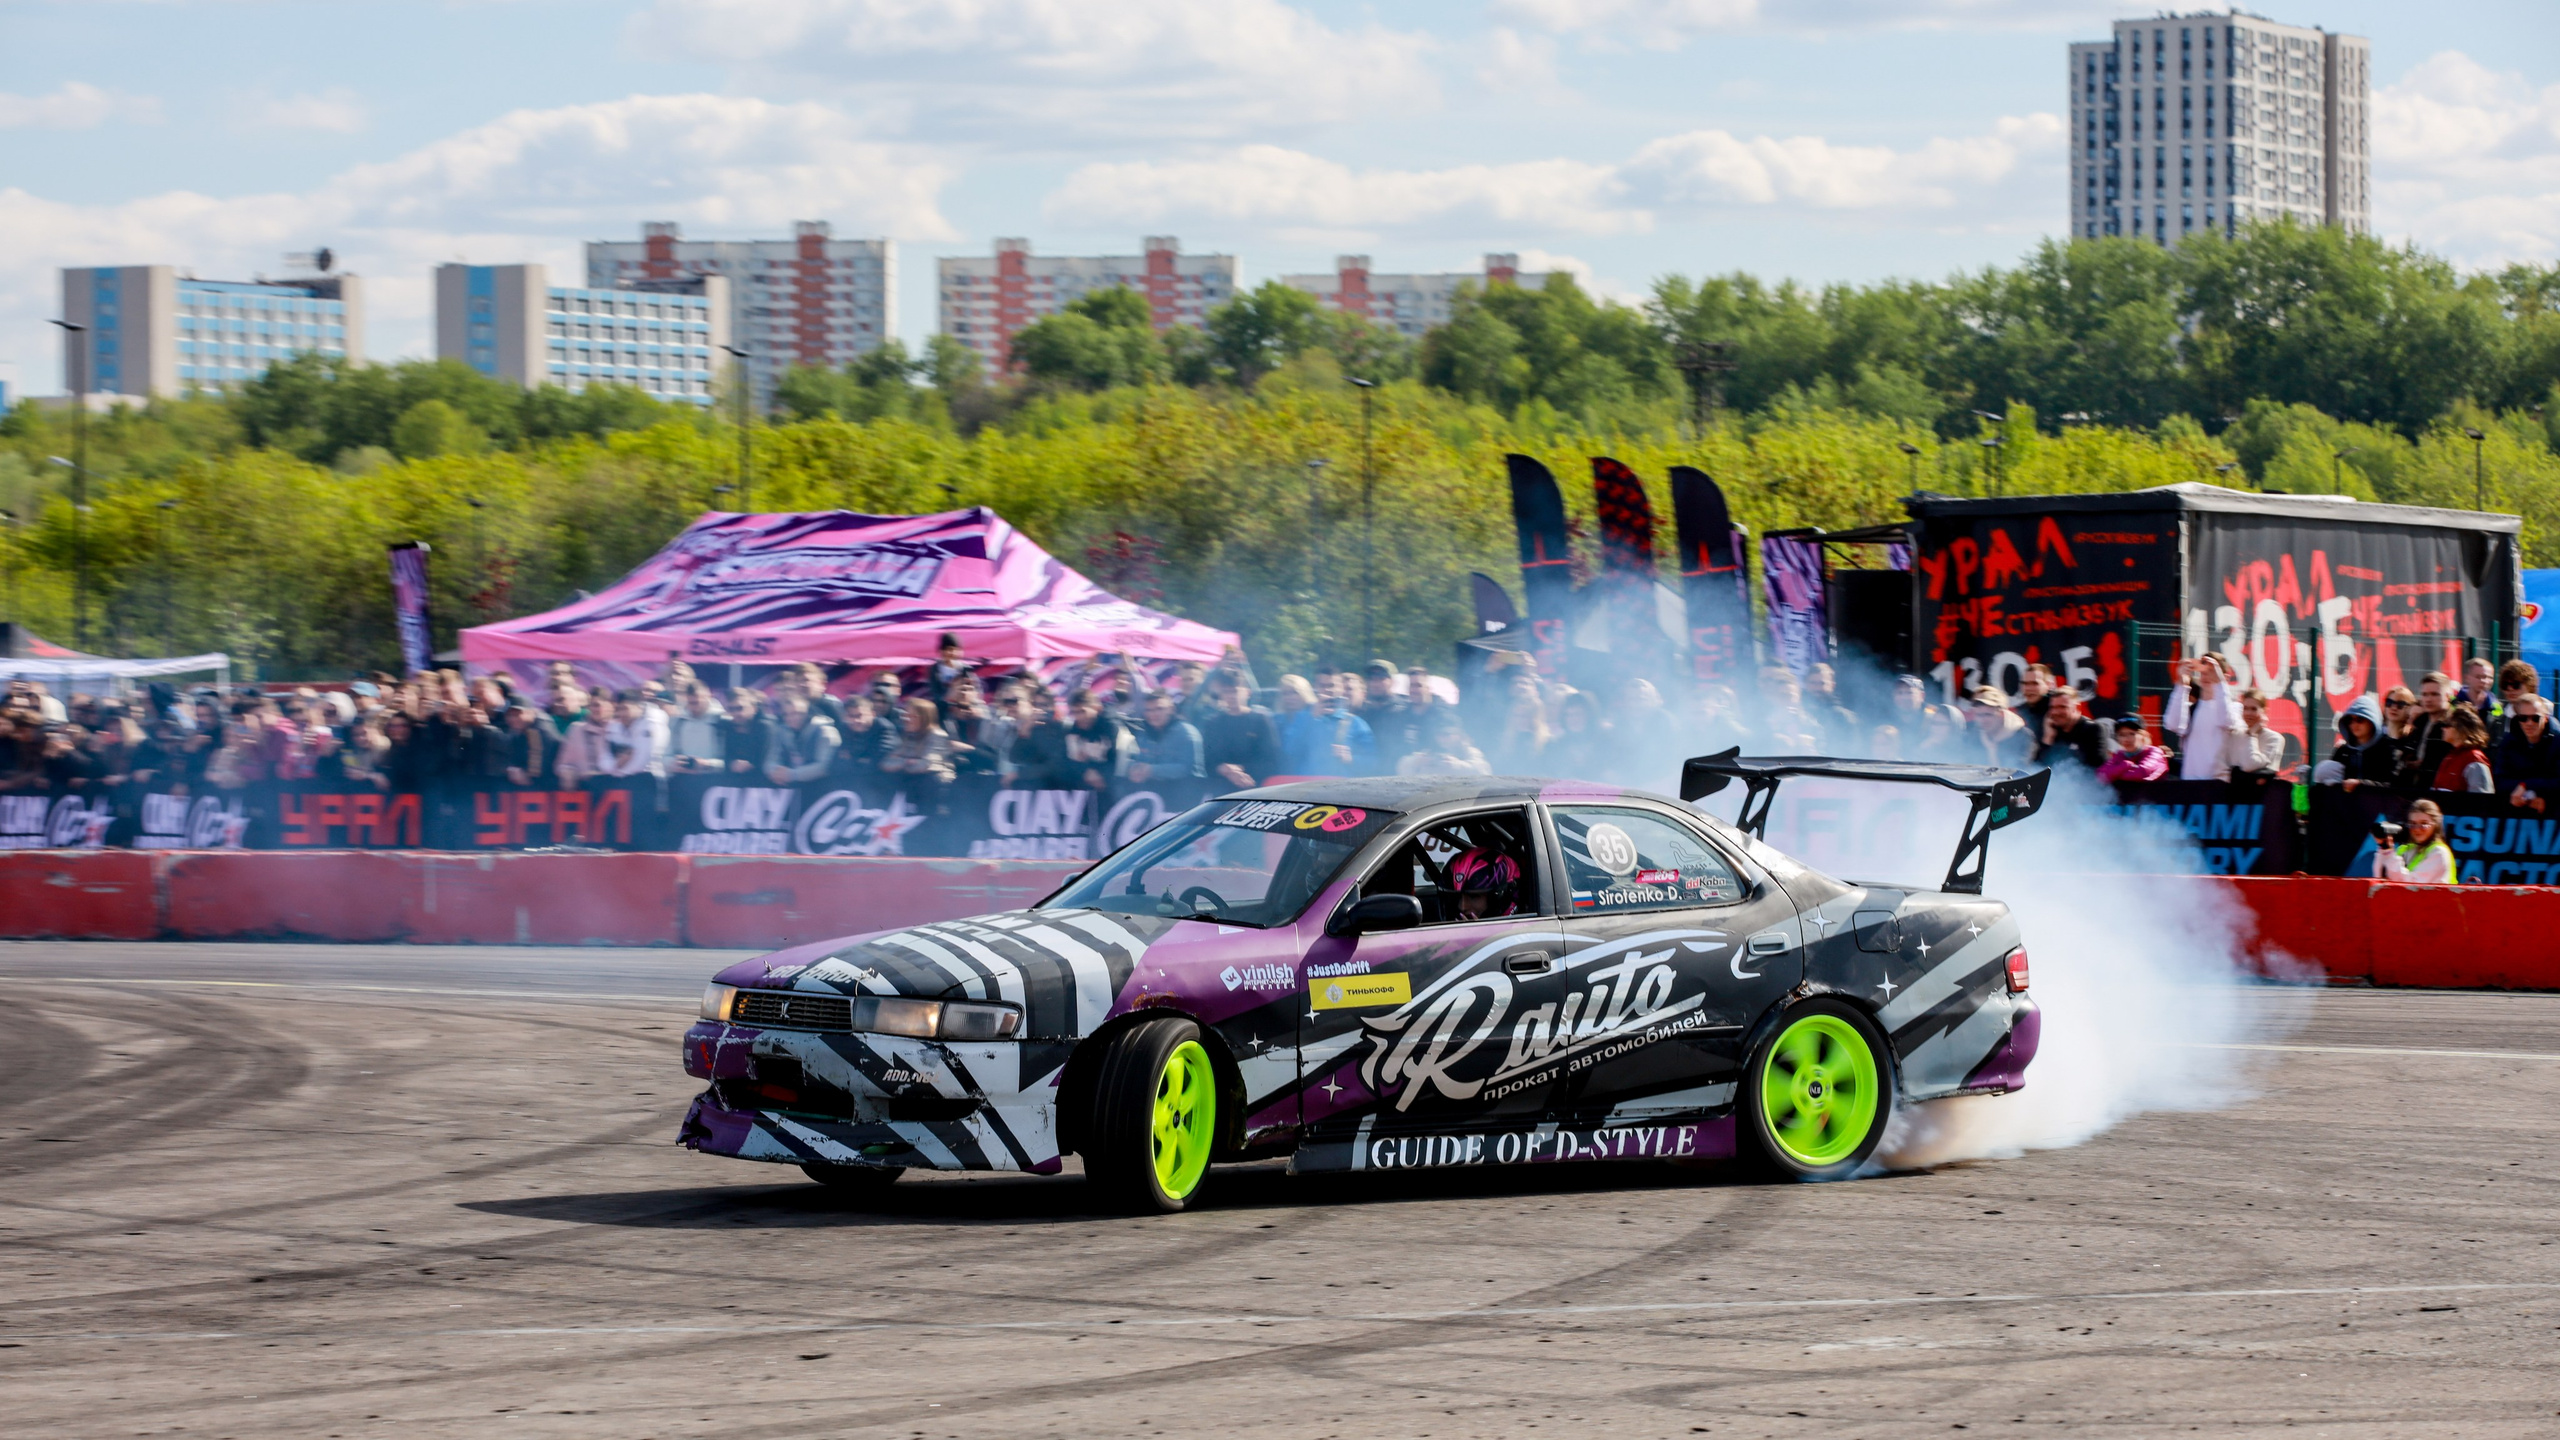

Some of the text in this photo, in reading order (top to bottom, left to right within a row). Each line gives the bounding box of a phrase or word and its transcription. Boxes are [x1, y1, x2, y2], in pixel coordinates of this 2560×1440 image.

[1919, 515, 2078, 600] УРАЛ
[2223, 549, 2337, 619] УРАЛ
[279, 793, 422, 845] УРАЛ
[473, 790, 632, 844] УРАЛ
[1248, 812, 1288, 830] FEST
[1595, 833, 1629, 866] 35
[1598, 886, 1664, 910] Sirotenko
[1668, 885, 1683, 905] D.
[1241, 963, 1295, 982] vinilsh
[1306, 960, 1371, 978] #JustDoDrift
[1346, 985, 1396, 997] ТИНЬКОФФ
[1483, 1009, 1708, 1102] прокат автомобилей
[1371, 1125, 1699, 1171] GUIDE OF D-STYLE
